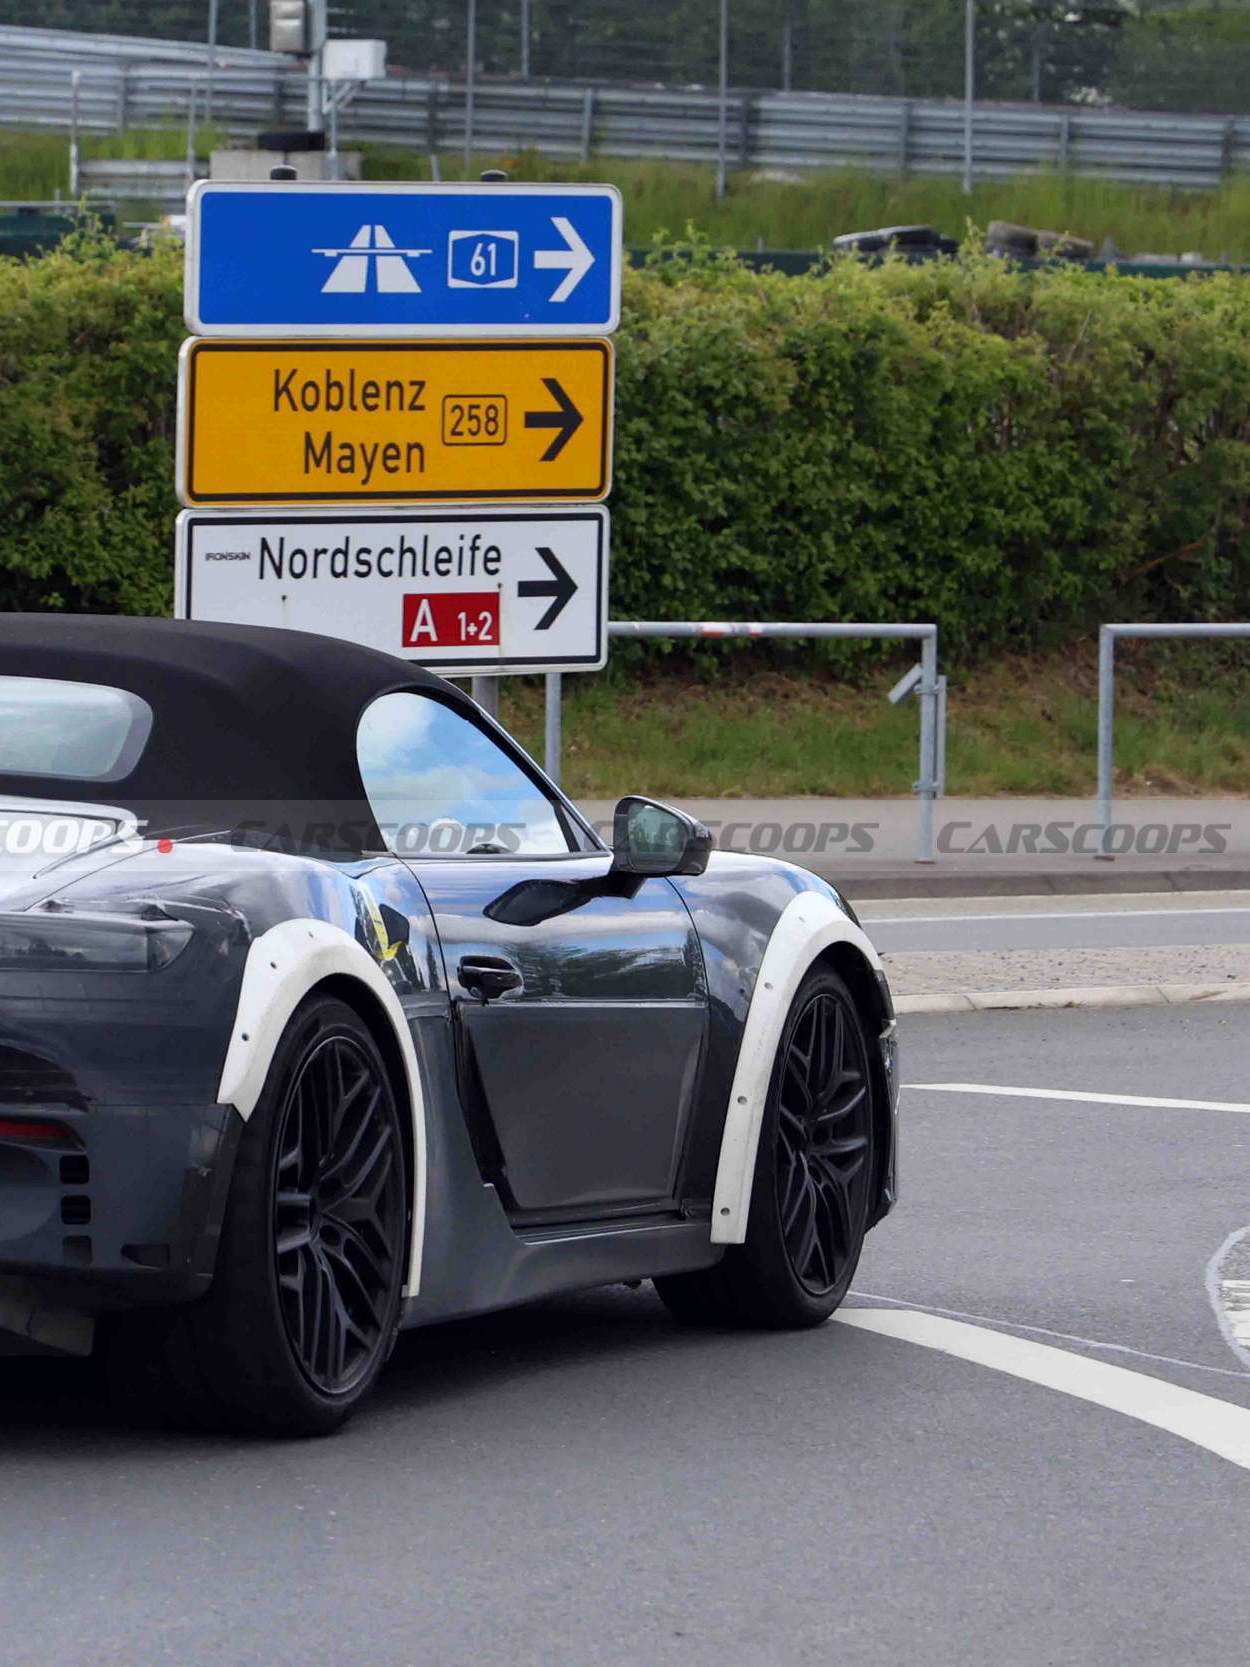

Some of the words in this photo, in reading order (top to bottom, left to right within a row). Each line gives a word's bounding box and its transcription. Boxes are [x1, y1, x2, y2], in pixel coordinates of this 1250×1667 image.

[470, 243, 496, 276] 61
[273, 368, 426, 412] Koblenz
[449, 404, 499, 436] 258
[303, 431, 425, 486] Mayen
[258, 533, 502, 580] Nordschleife
[410, 598, 438, 642] A
[457, 611, 493, 641] 1+2
